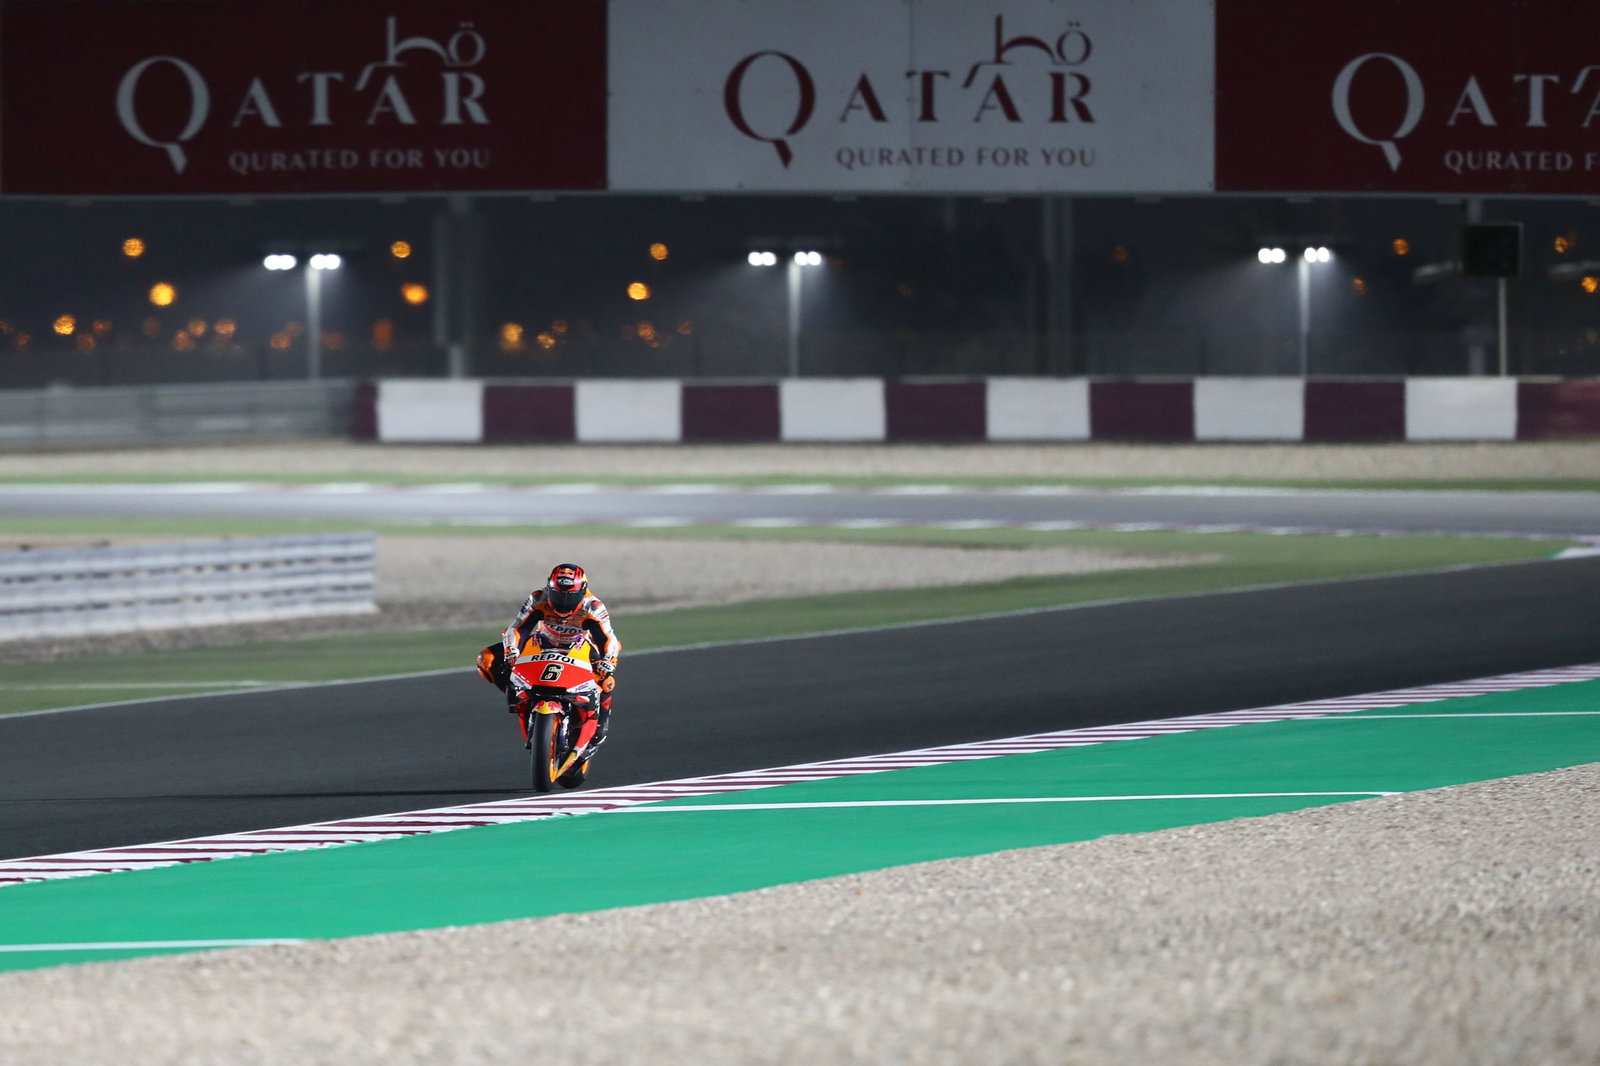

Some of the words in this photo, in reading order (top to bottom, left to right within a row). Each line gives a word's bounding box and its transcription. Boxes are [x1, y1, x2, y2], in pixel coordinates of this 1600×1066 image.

[117, 56, 490, 174] QATAR
[723, 51, 1095, 168] QATAR
[229, 149, 360, 175] QURATED
[369, 148, 424, 169] FOR
[433, 148, 490, 169] YOU
[835, 146, 965, 171] QURATED
[976, 147, 1030, 167] FOR
[1040, 147, 1096, 167] YOU
[1444, 151, 1574, 174] QURATED
[531, 653, 576, 665] REPSOL
[540, 663, 564, 682] 6
